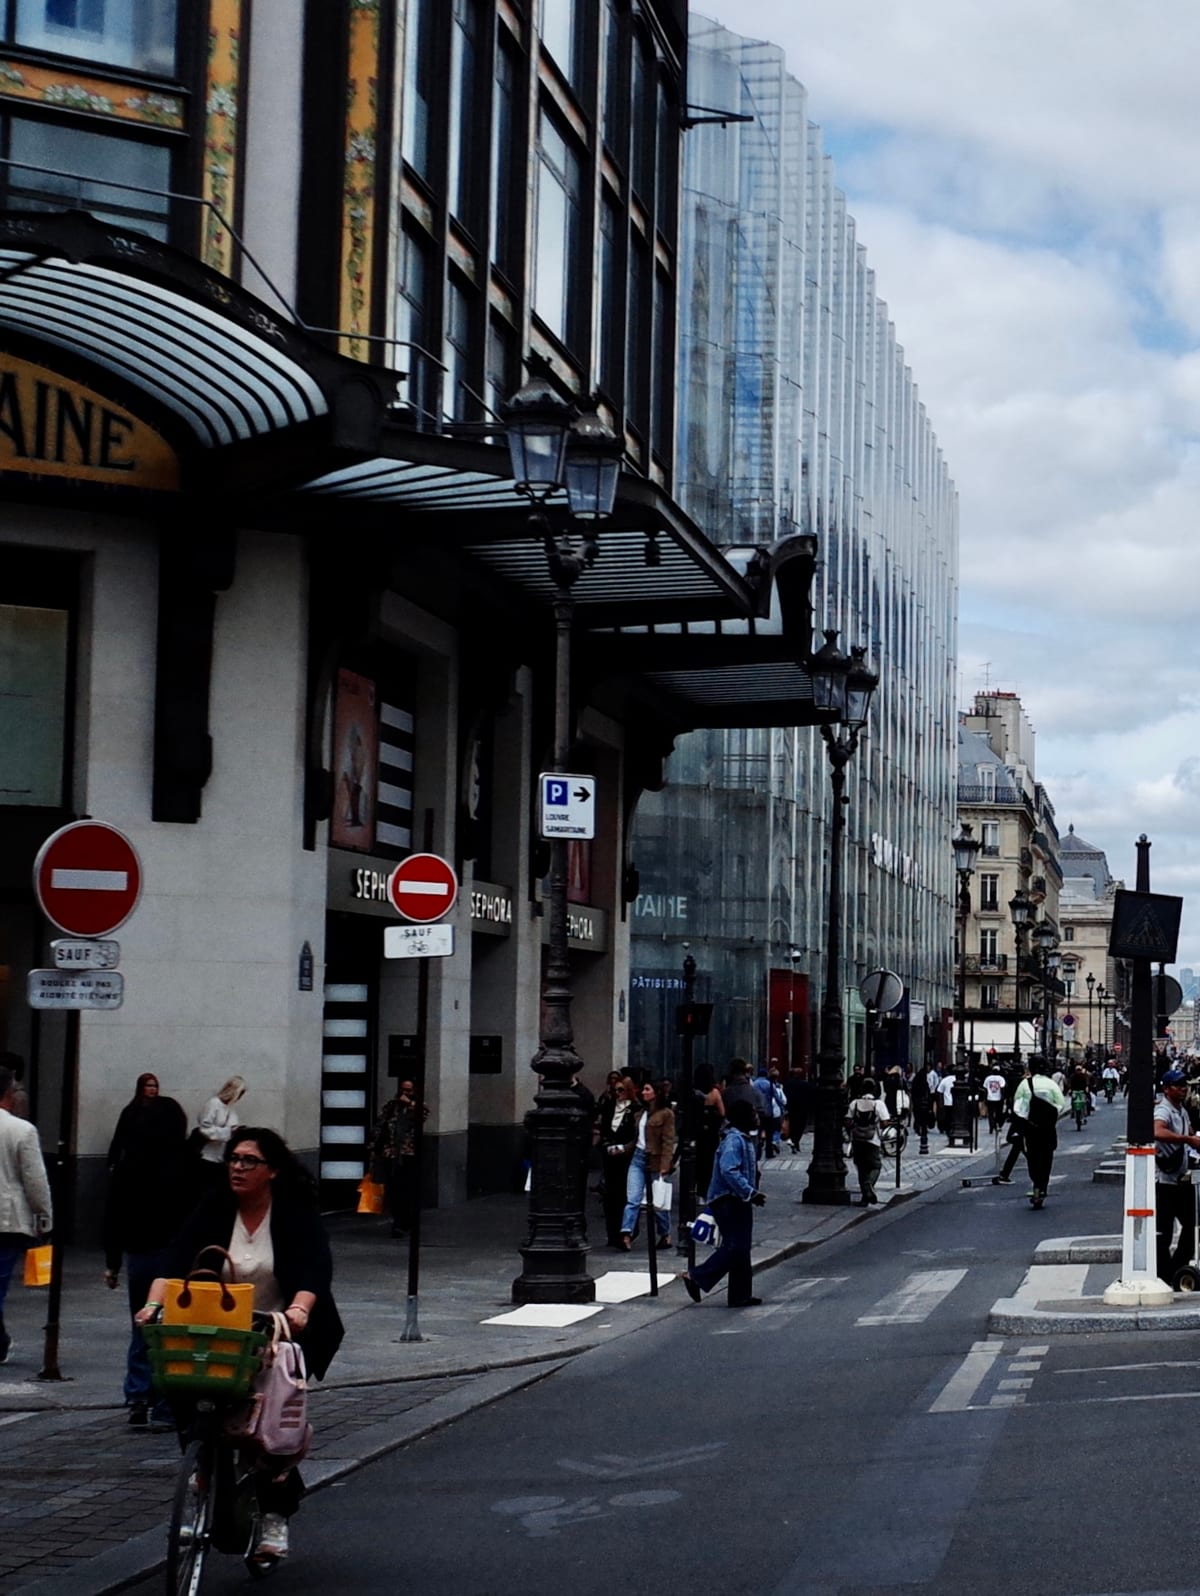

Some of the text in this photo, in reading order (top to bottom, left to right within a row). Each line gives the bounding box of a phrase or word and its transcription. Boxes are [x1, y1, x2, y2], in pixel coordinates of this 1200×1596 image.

[356, 868, 392, 902] SEPH
[470, 892, 512, 924] SEPHORA
[404, 928, 432, 939] SAUF
[566, 913, 593, 941] EPHORA
[57, 948, 91, 961] SAUF
